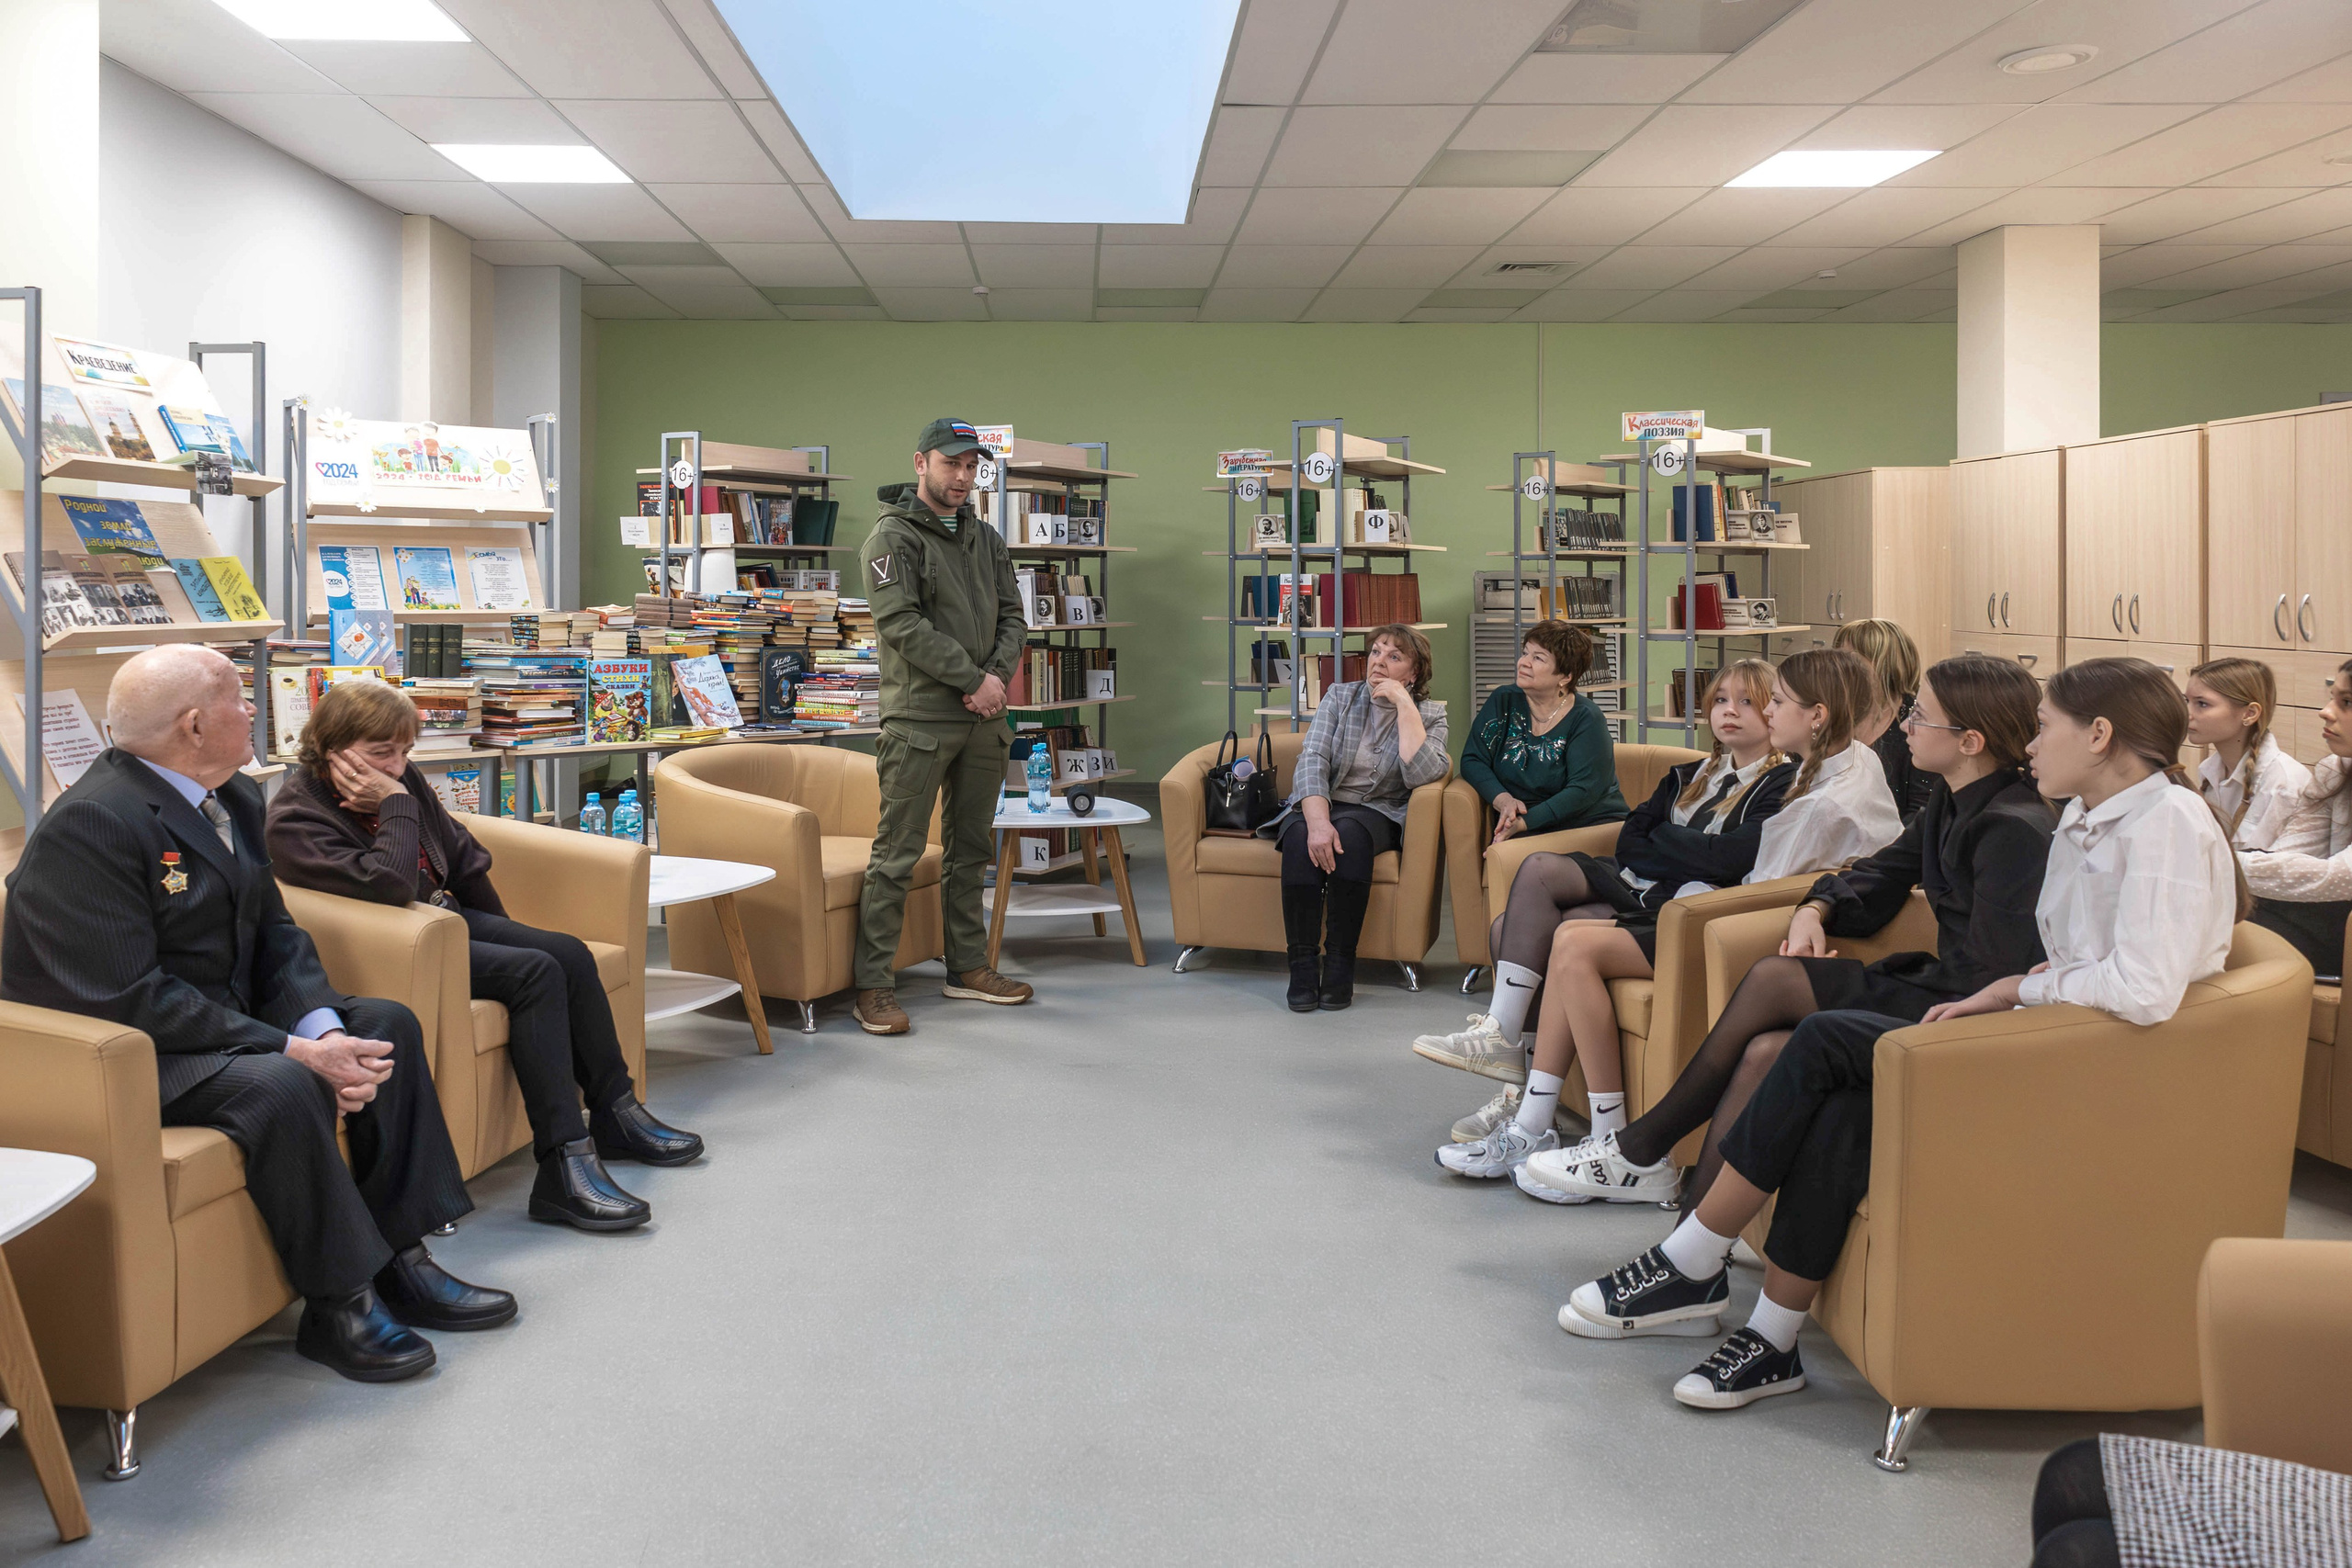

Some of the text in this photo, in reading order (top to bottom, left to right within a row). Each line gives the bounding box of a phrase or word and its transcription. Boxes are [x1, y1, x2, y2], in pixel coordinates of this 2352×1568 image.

[1628, 416, 1699, 432] Классическая
[1644, 427, 1685, 437] ПОЭЗИЯ
[1653, 451, 1685, 468] 16+
[321, 462, 358, 479] 2024
[672, 467, 694, 482] 16+
[1305, 459, 1334, 476] 16+
[1238, 483, 1261, 496] 16+
[1525, 482, 1548, 495] 16+
[64, 499, 107, 513] Родной
[1368, 514, 1384, 529] Ф
[1035, 522, 1048, 536] А
[1055, 523, 1065, 537] Б
[85, 536, 157, 549] заслуженные
[1073, 607, 1084, 621] В
[594, 663, 649, 673] АЗБУКИ
[602, 675, 640, 683] СТИХИ
[1100, 677, 1111, 694] Д
[1067, 759, 1084, 773] Ж
[1091, 756, 1101, 771] З
[1102, 756, 1115, 771] И
[1034, 846, 1046, 862] К
